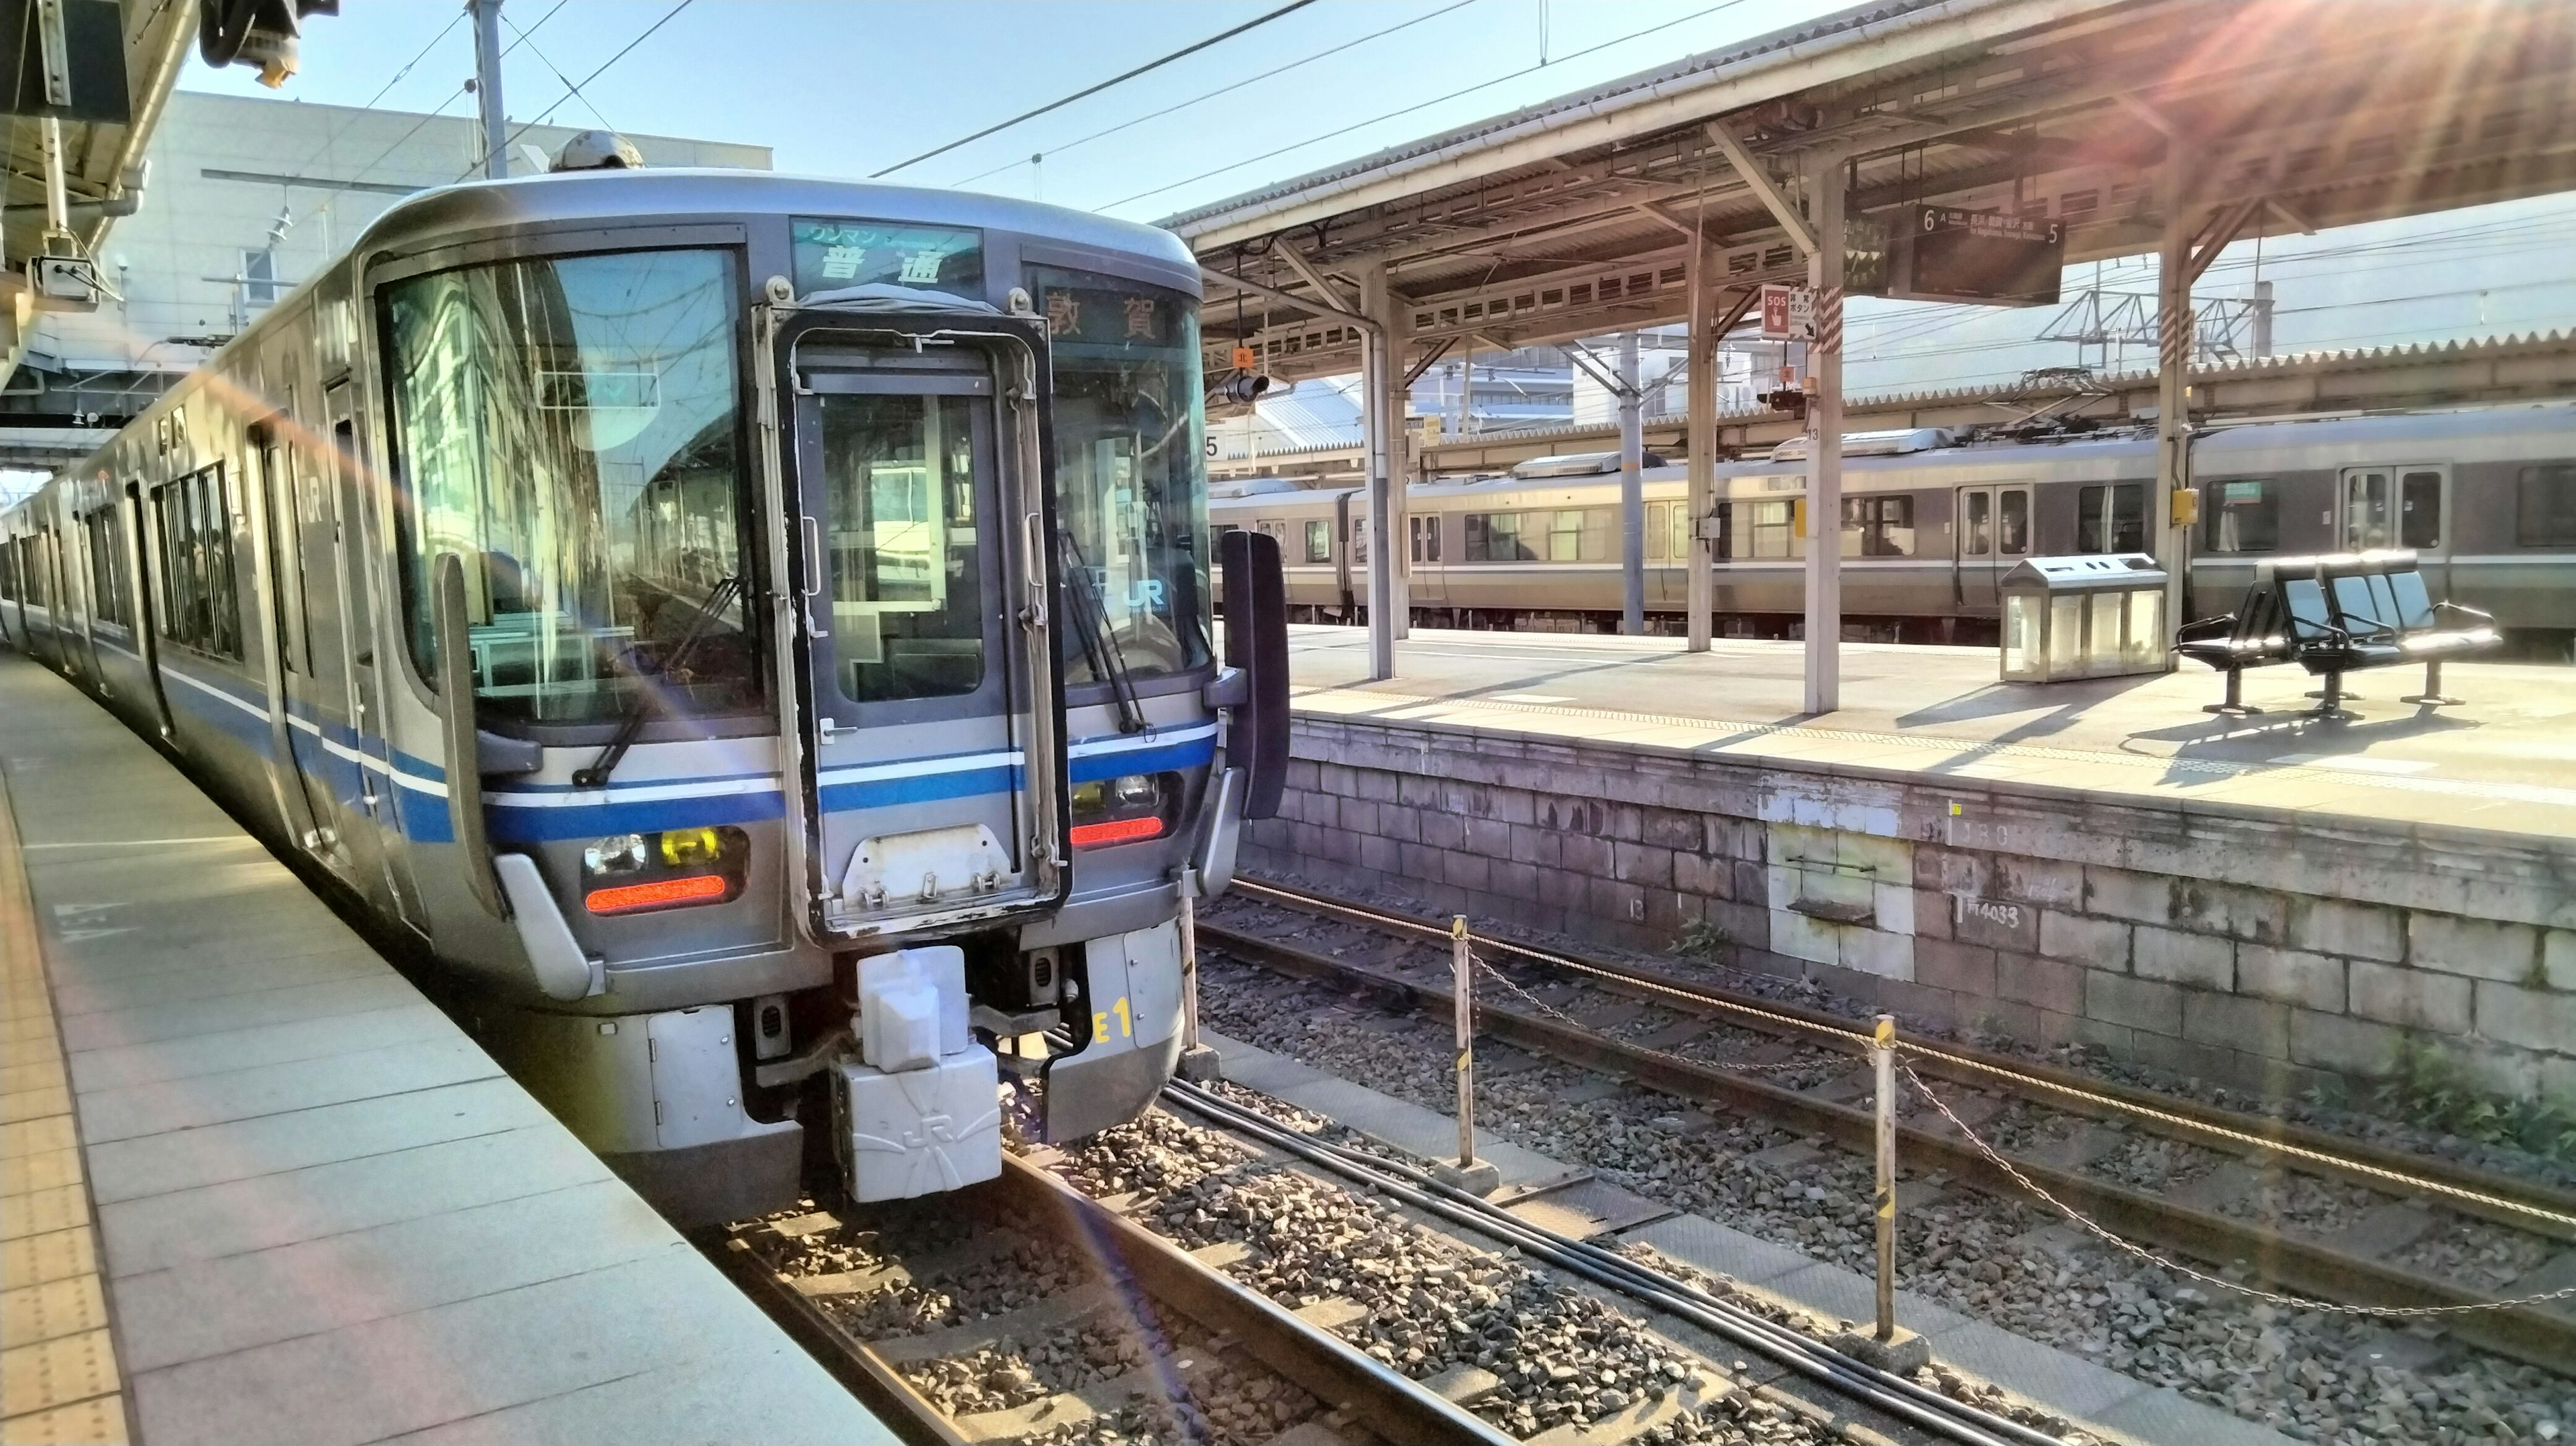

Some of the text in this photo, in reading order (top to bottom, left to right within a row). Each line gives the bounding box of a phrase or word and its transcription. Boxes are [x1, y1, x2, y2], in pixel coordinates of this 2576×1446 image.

[1925, 209, 1935, 231] 6
[1940, 213, 1946, 222] A
[2049, 223, 2058, 243] 5
[1767, 295, 1786, 307] SOS
[1790, 304, 1809, 313] ボタン
[1238, 353, 1248, 363] 北
[1807, 429, 1819, 441] 13
[1206, 436, 1218, 457] 5
[1365, 466, 1373, 476] 12
[307, 476, 323, 523] JR
[1122, 579, 1165, 607] JR
[1092, 997, 1132, 1044] E1
[902, 1114, 955, 1149] JR
